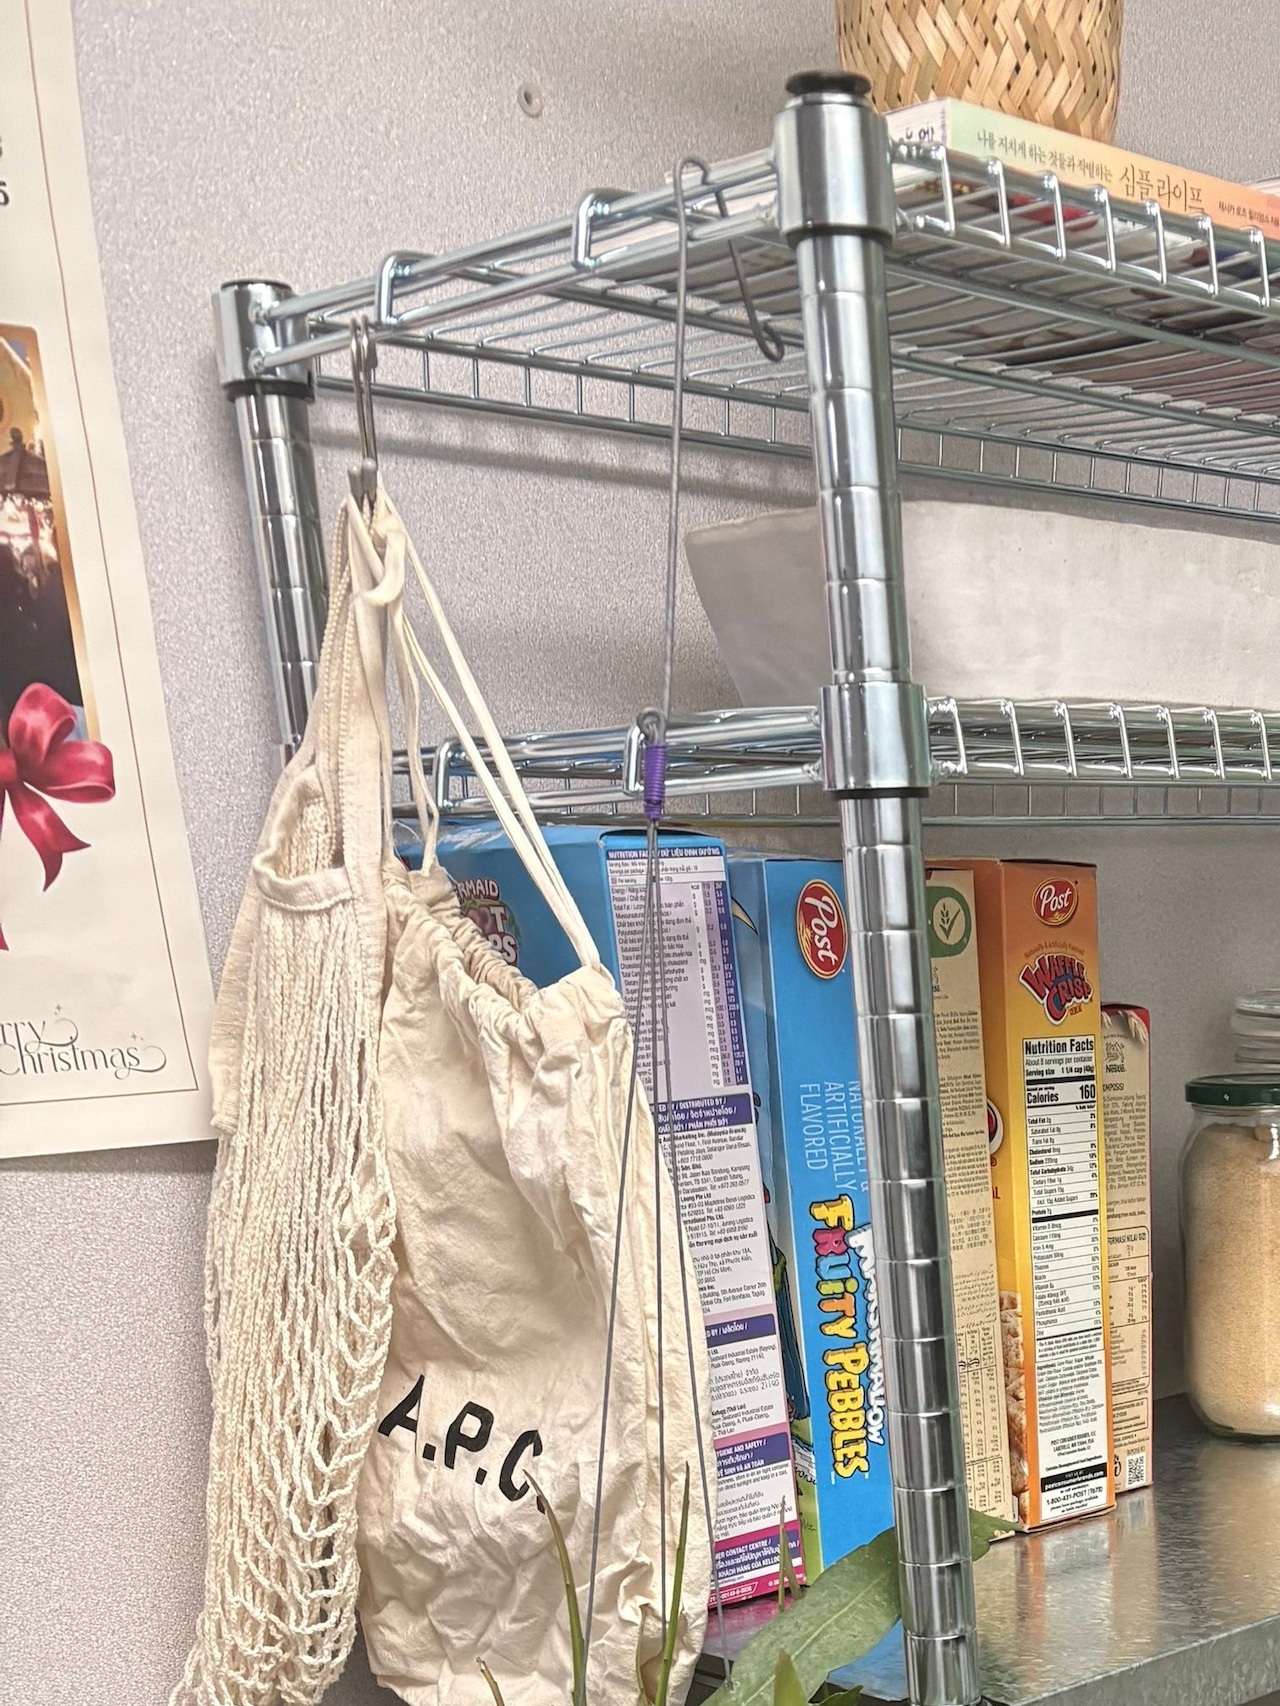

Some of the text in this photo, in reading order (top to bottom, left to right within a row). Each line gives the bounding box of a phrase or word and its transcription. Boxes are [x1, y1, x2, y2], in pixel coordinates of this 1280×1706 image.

[998, 135, 1027, 159] 지치게
[1028, 144, 1049, 165] 하는
[1039, 885, 1071, 917] Post
[804, 892, 841, 964] Post
[1020, 954, 1085, 1002] WAFFLE
[1046, 978, 1092, 1021] CRISP
[1025, 1038, 1094, 1055] Nutrition Facts
[1026, 1069, 1044, 1077] Serving
[1026, 1084, 1096, 1104] Calories 160
[799, 1083, 829, 1171] FLAVORED
[824, 1081, 856, 1191] ARTIFICIALLY
[824, 1342, 869, 1478] PEBBLES
[716, 1444, 733, 1457] YGIENE
[745, 1440, 763, 1451] SAFETY
[726, 1545, 748, 1558] CONTACT
[749, 1539, 768, 1551] CENTRE
[763, 1555, 781, 1566] KELLO
